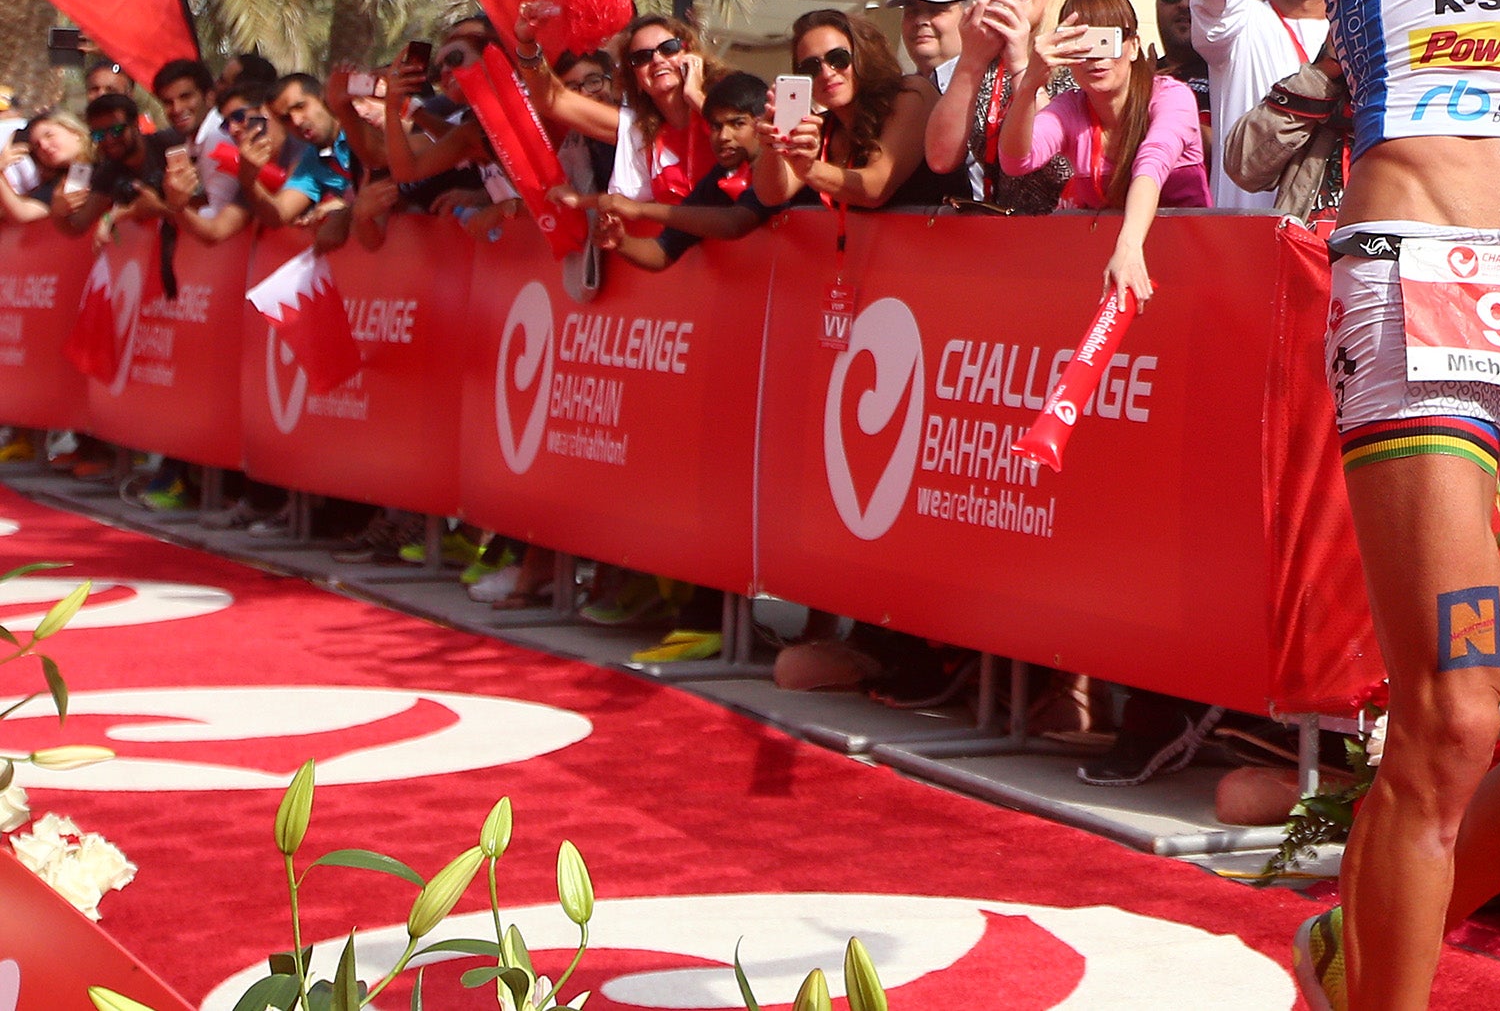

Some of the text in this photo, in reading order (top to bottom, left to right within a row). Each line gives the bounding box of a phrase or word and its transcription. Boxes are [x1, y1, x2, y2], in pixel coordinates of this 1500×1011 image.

[343, 298, 417, 343] LLENGE
[560, 313, 694, 374] CHALLENGE
[1077, 290, 1120, 368] earetriathlon!
[551, 374, 624, 427] BAHRAIN
[935, 339, 1158, 423] CHALLEGE
[917, 485, 1056, 539] wearetriathlon!
